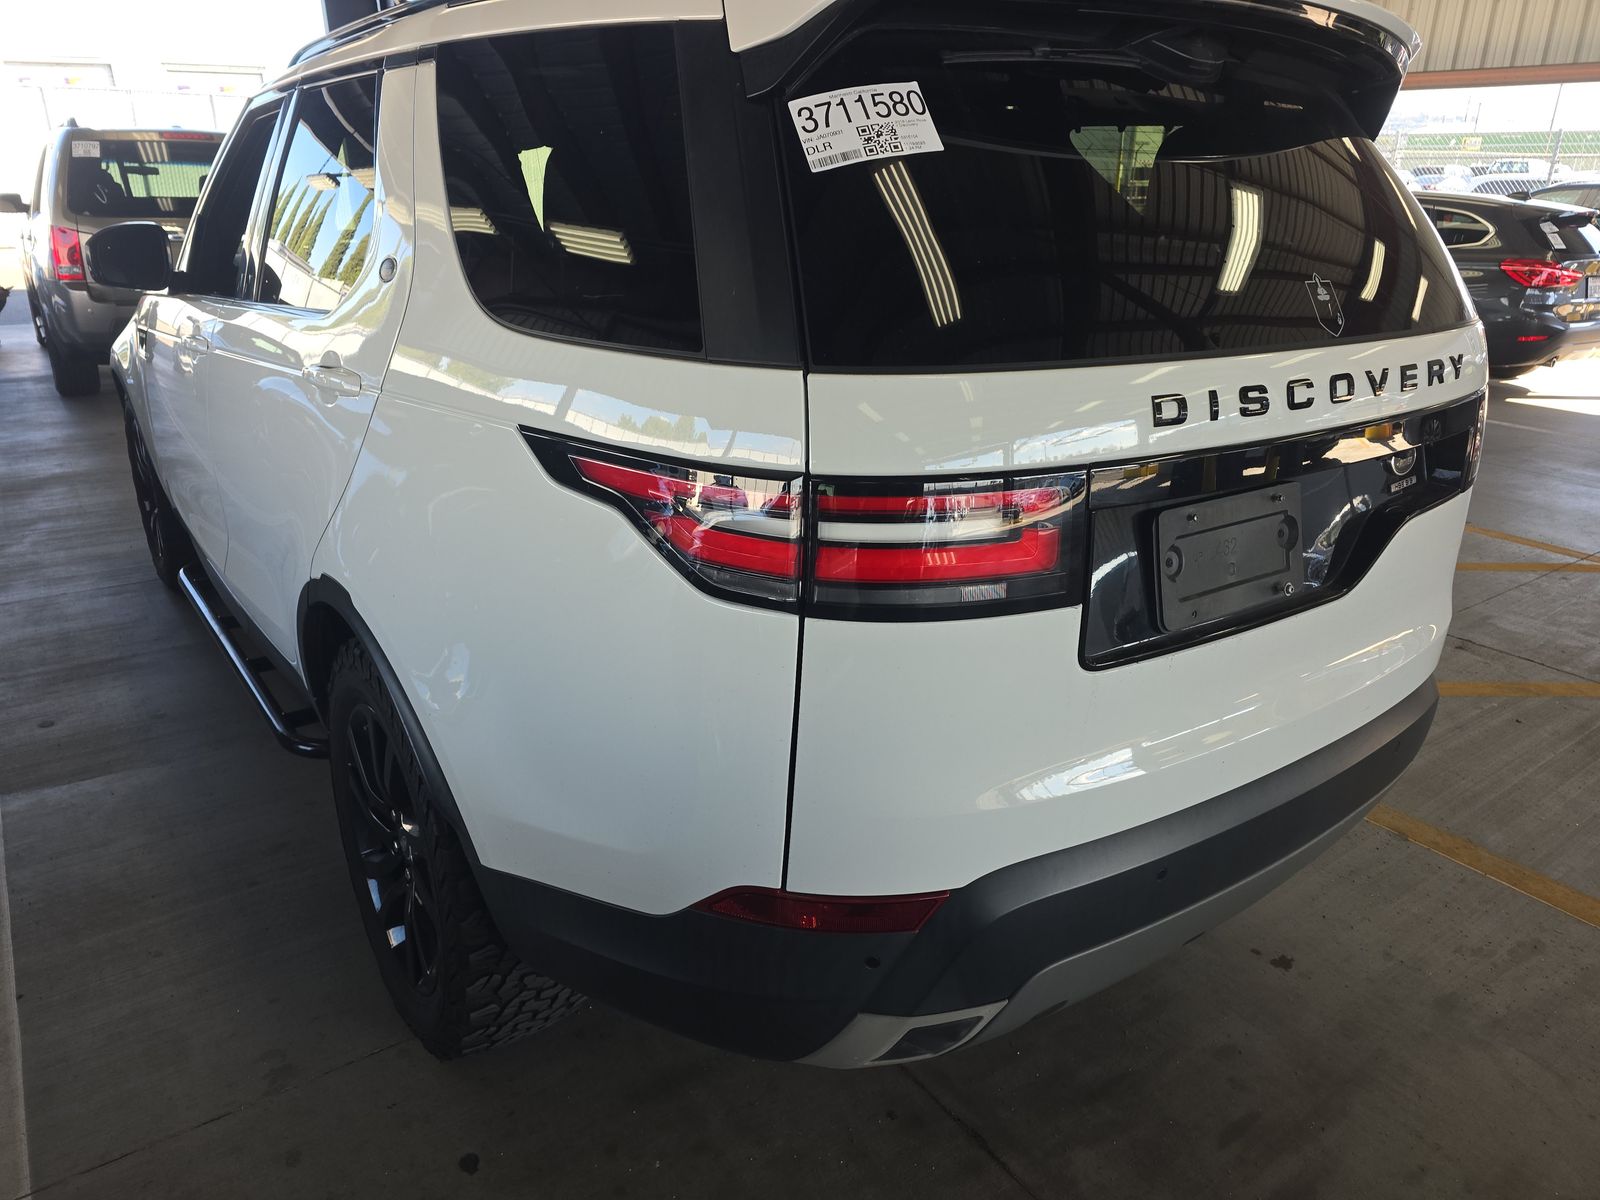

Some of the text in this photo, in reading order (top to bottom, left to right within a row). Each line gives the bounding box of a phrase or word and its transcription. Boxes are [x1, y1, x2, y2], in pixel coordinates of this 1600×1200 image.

[797, 90, 927, 133] 3711580
[806, 141, 833, 156] DLR
[1151, 353, 1464, 428] DISCOVERY
